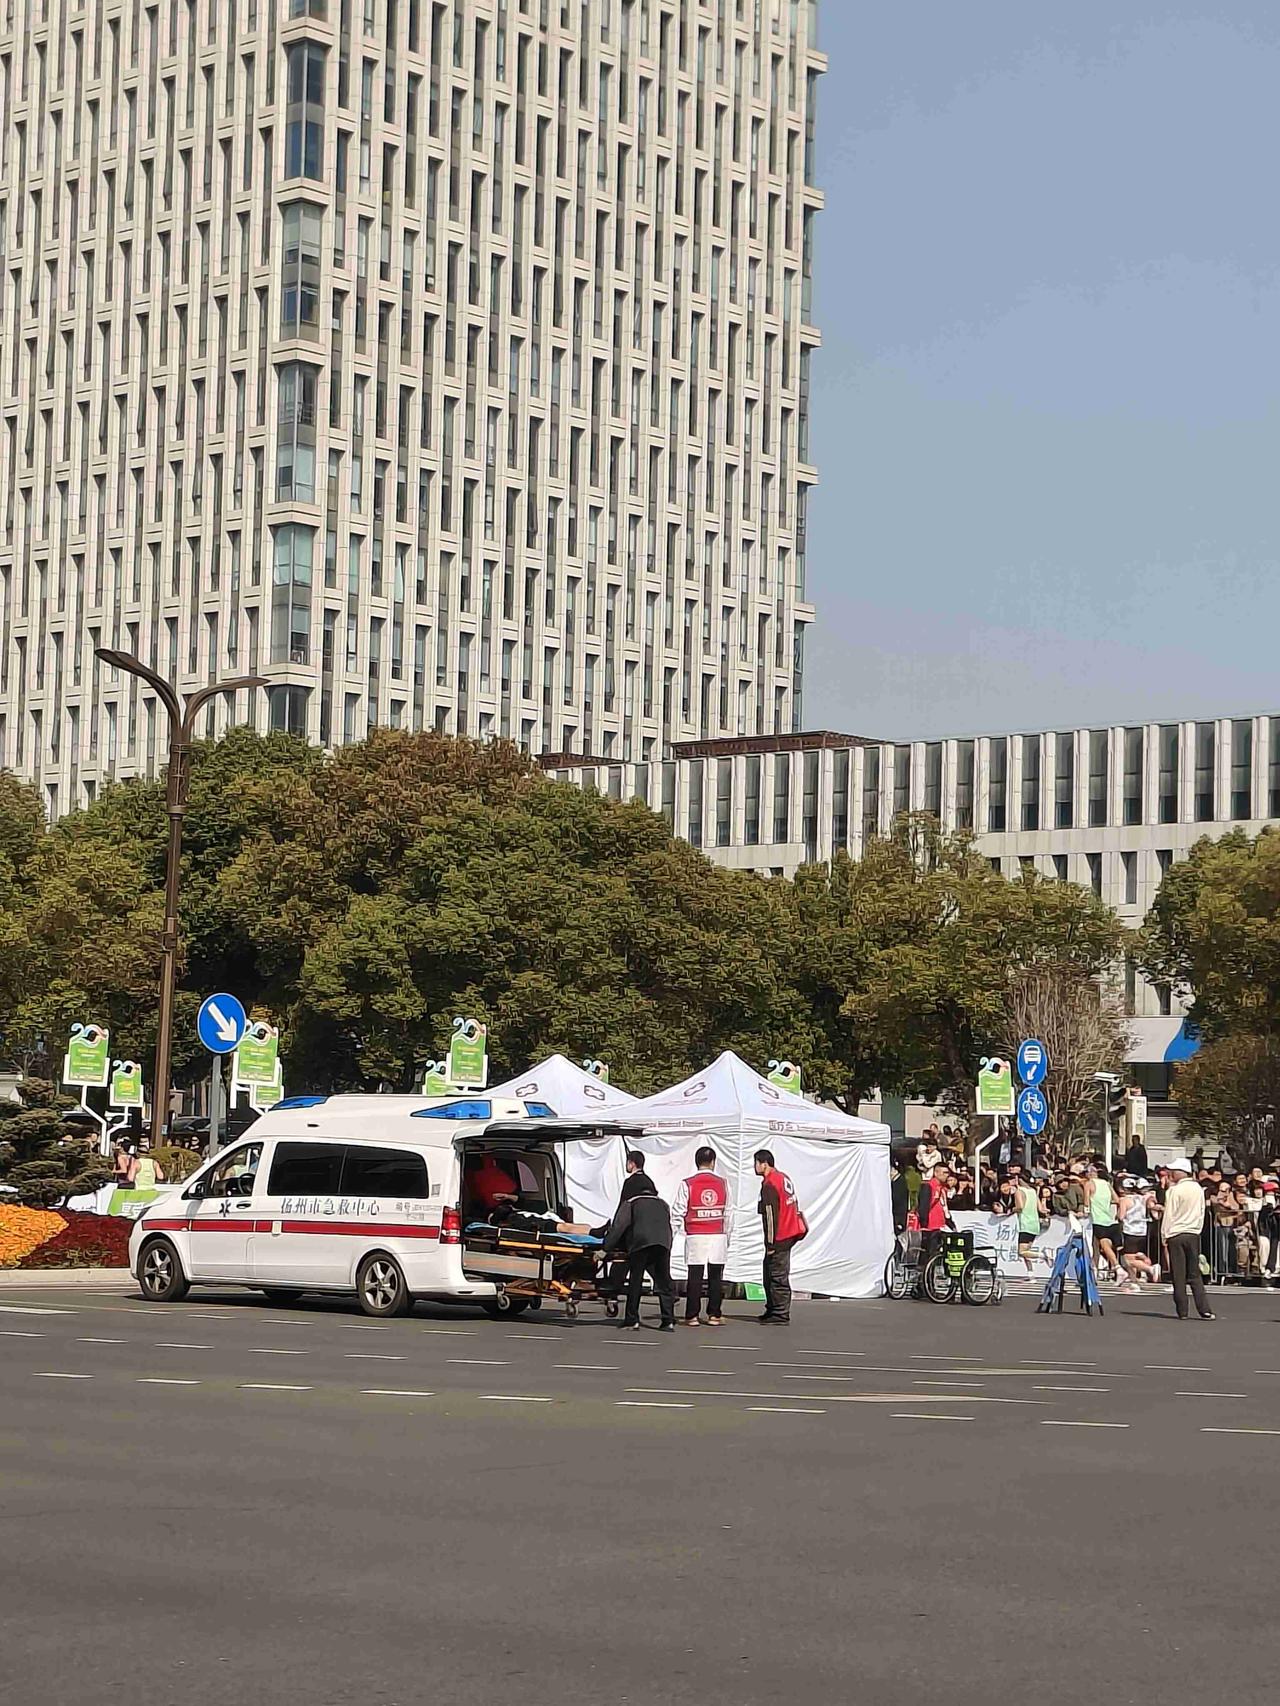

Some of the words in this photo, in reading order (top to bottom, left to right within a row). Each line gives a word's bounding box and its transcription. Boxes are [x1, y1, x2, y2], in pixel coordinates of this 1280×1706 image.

[281, 1197, 381, 1217] 扬州市急救中心
